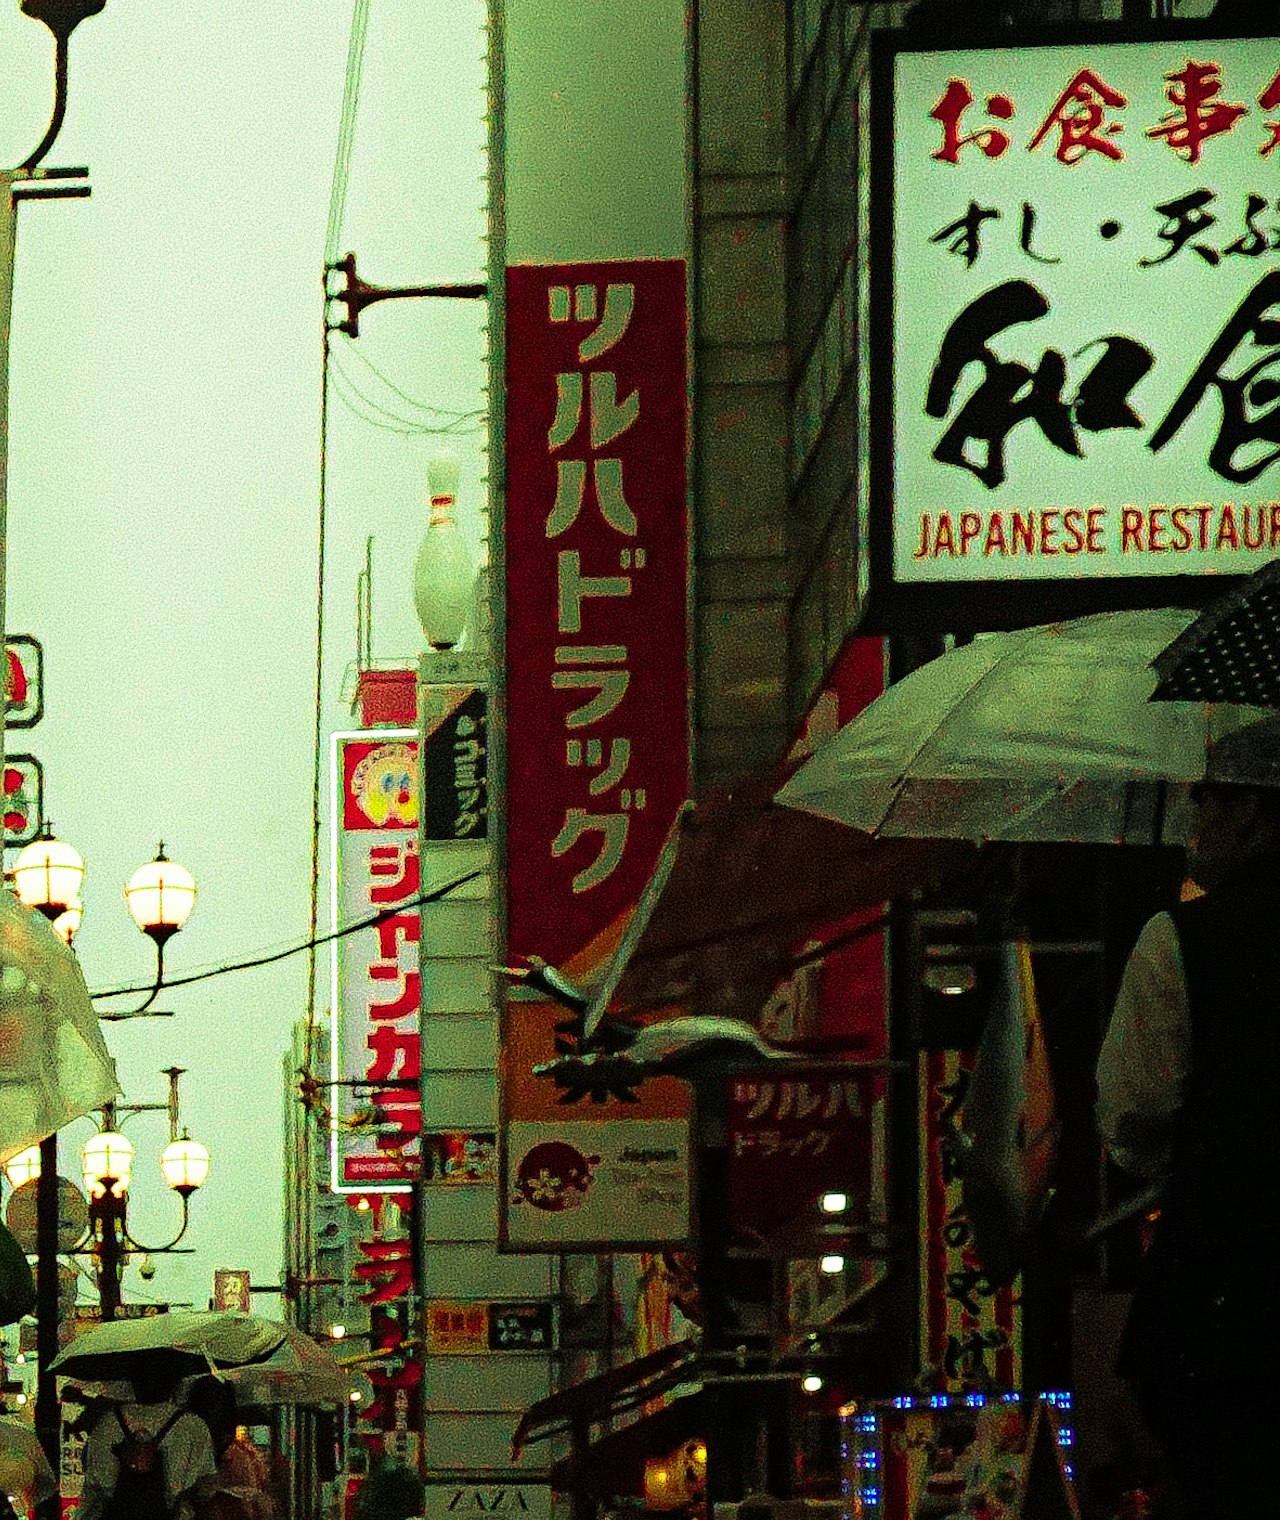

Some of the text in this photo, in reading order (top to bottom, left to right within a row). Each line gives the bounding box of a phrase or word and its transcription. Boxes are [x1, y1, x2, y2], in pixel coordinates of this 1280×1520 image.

[914, 508, 1107, 559] JAPANESE
[544, 282, 647, 896] ツルハドラッグ
[735, 1082, 864, 1120] ツルハ
[734, 1131, 831, 1158] ドラッグ
